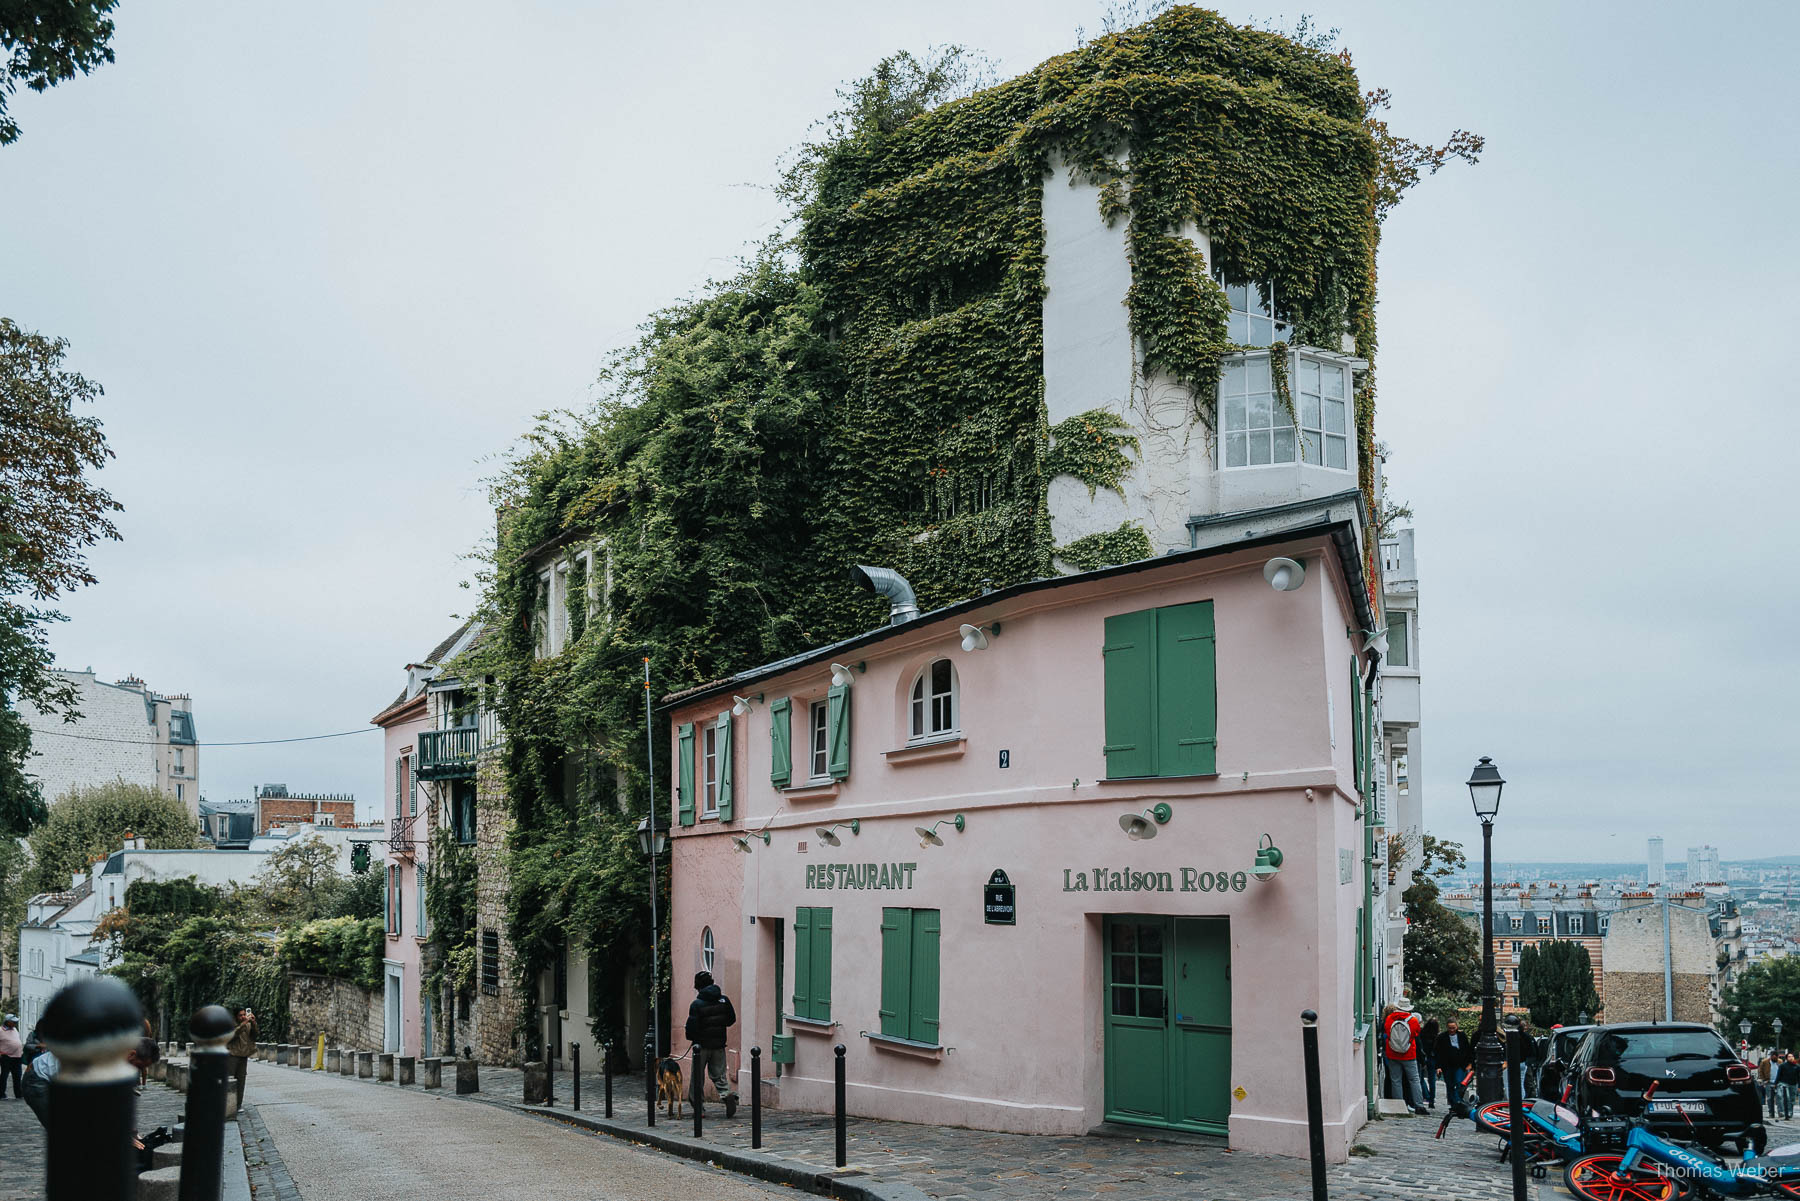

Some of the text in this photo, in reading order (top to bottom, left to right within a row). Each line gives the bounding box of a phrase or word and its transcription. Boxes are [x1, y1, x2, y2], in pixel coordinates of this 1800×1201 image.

[805, 862, 917, 890] RESTAURANT
[1062, 866, 1248, 893] La Maison Rose
[1668, 1149, 1704, 1169] dott
